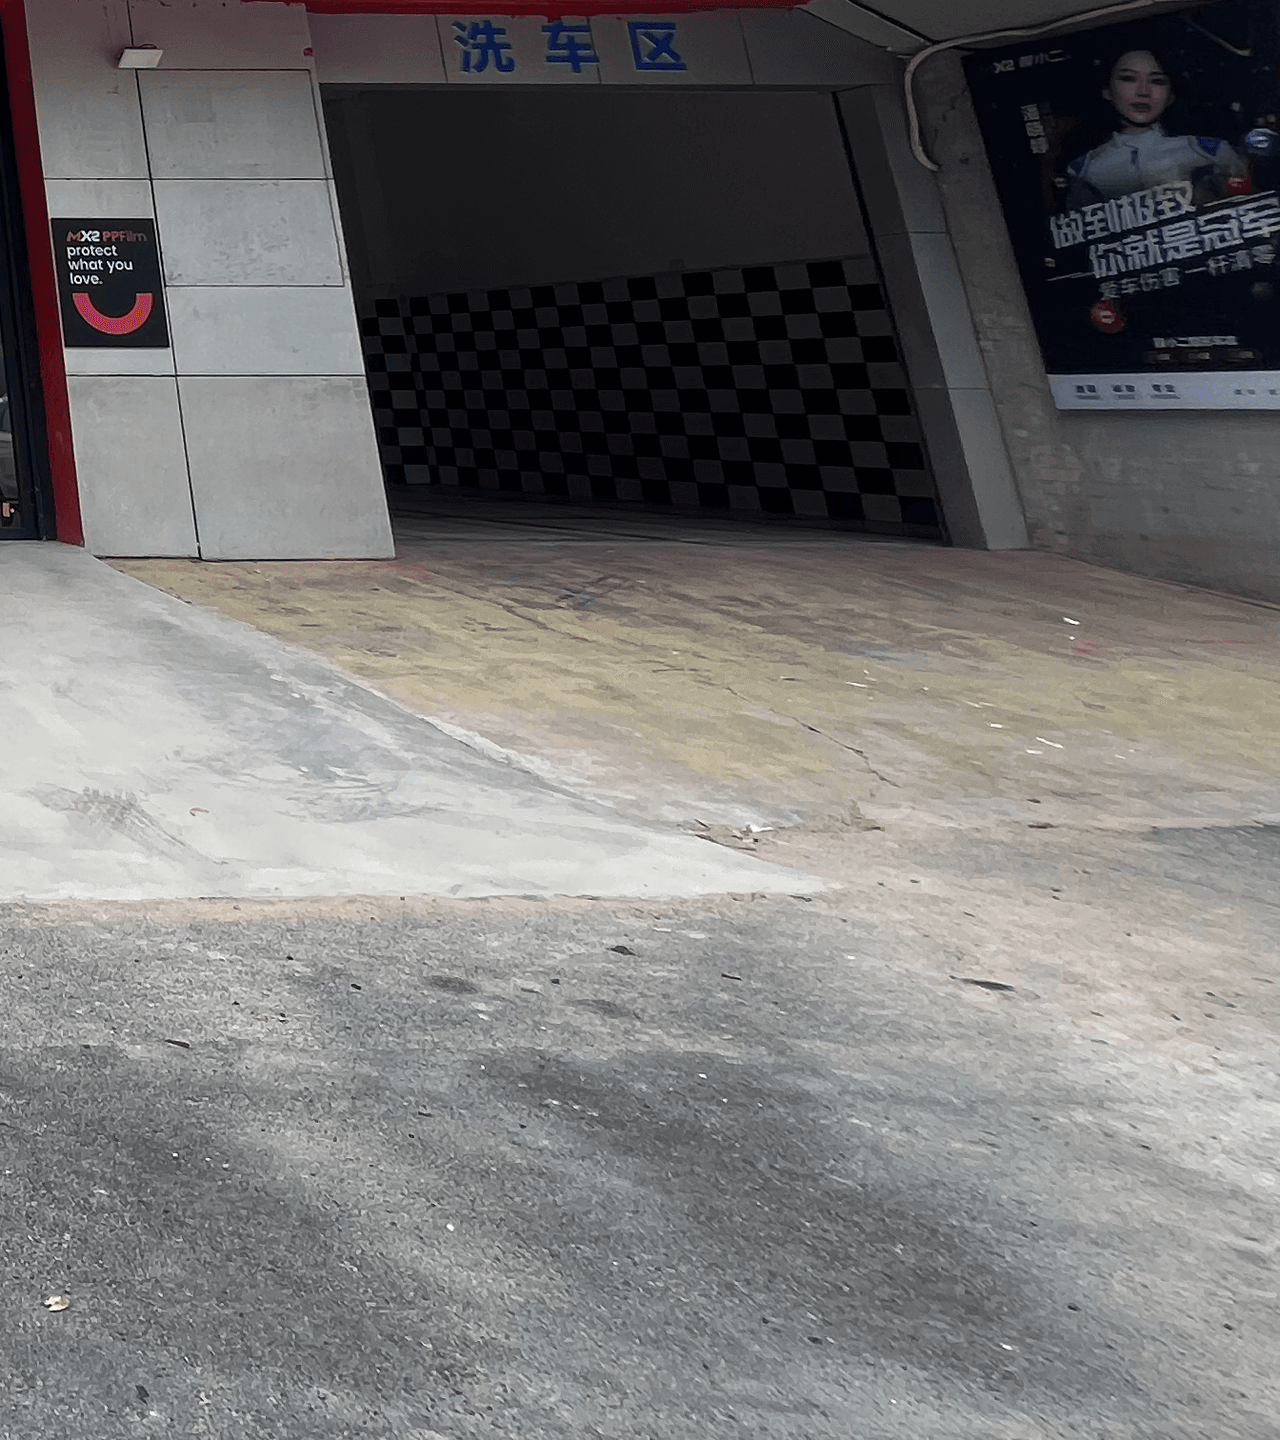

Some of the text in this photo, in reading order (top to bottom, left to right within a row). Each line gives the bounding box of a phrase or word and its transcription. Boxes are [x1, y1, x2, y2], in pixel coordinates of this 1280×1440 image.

[452, 20, 687, 74] 洗车区
[1050, 180, 1197, 249] 做到极致
[66, 230, 100, 242] MX2
[1089, 195, 1280, 279] 你就是冠军
[66, 245, 118, 259] protect
[68, 258, 133, 274] what you
[69, 272, 103, 285] love.
